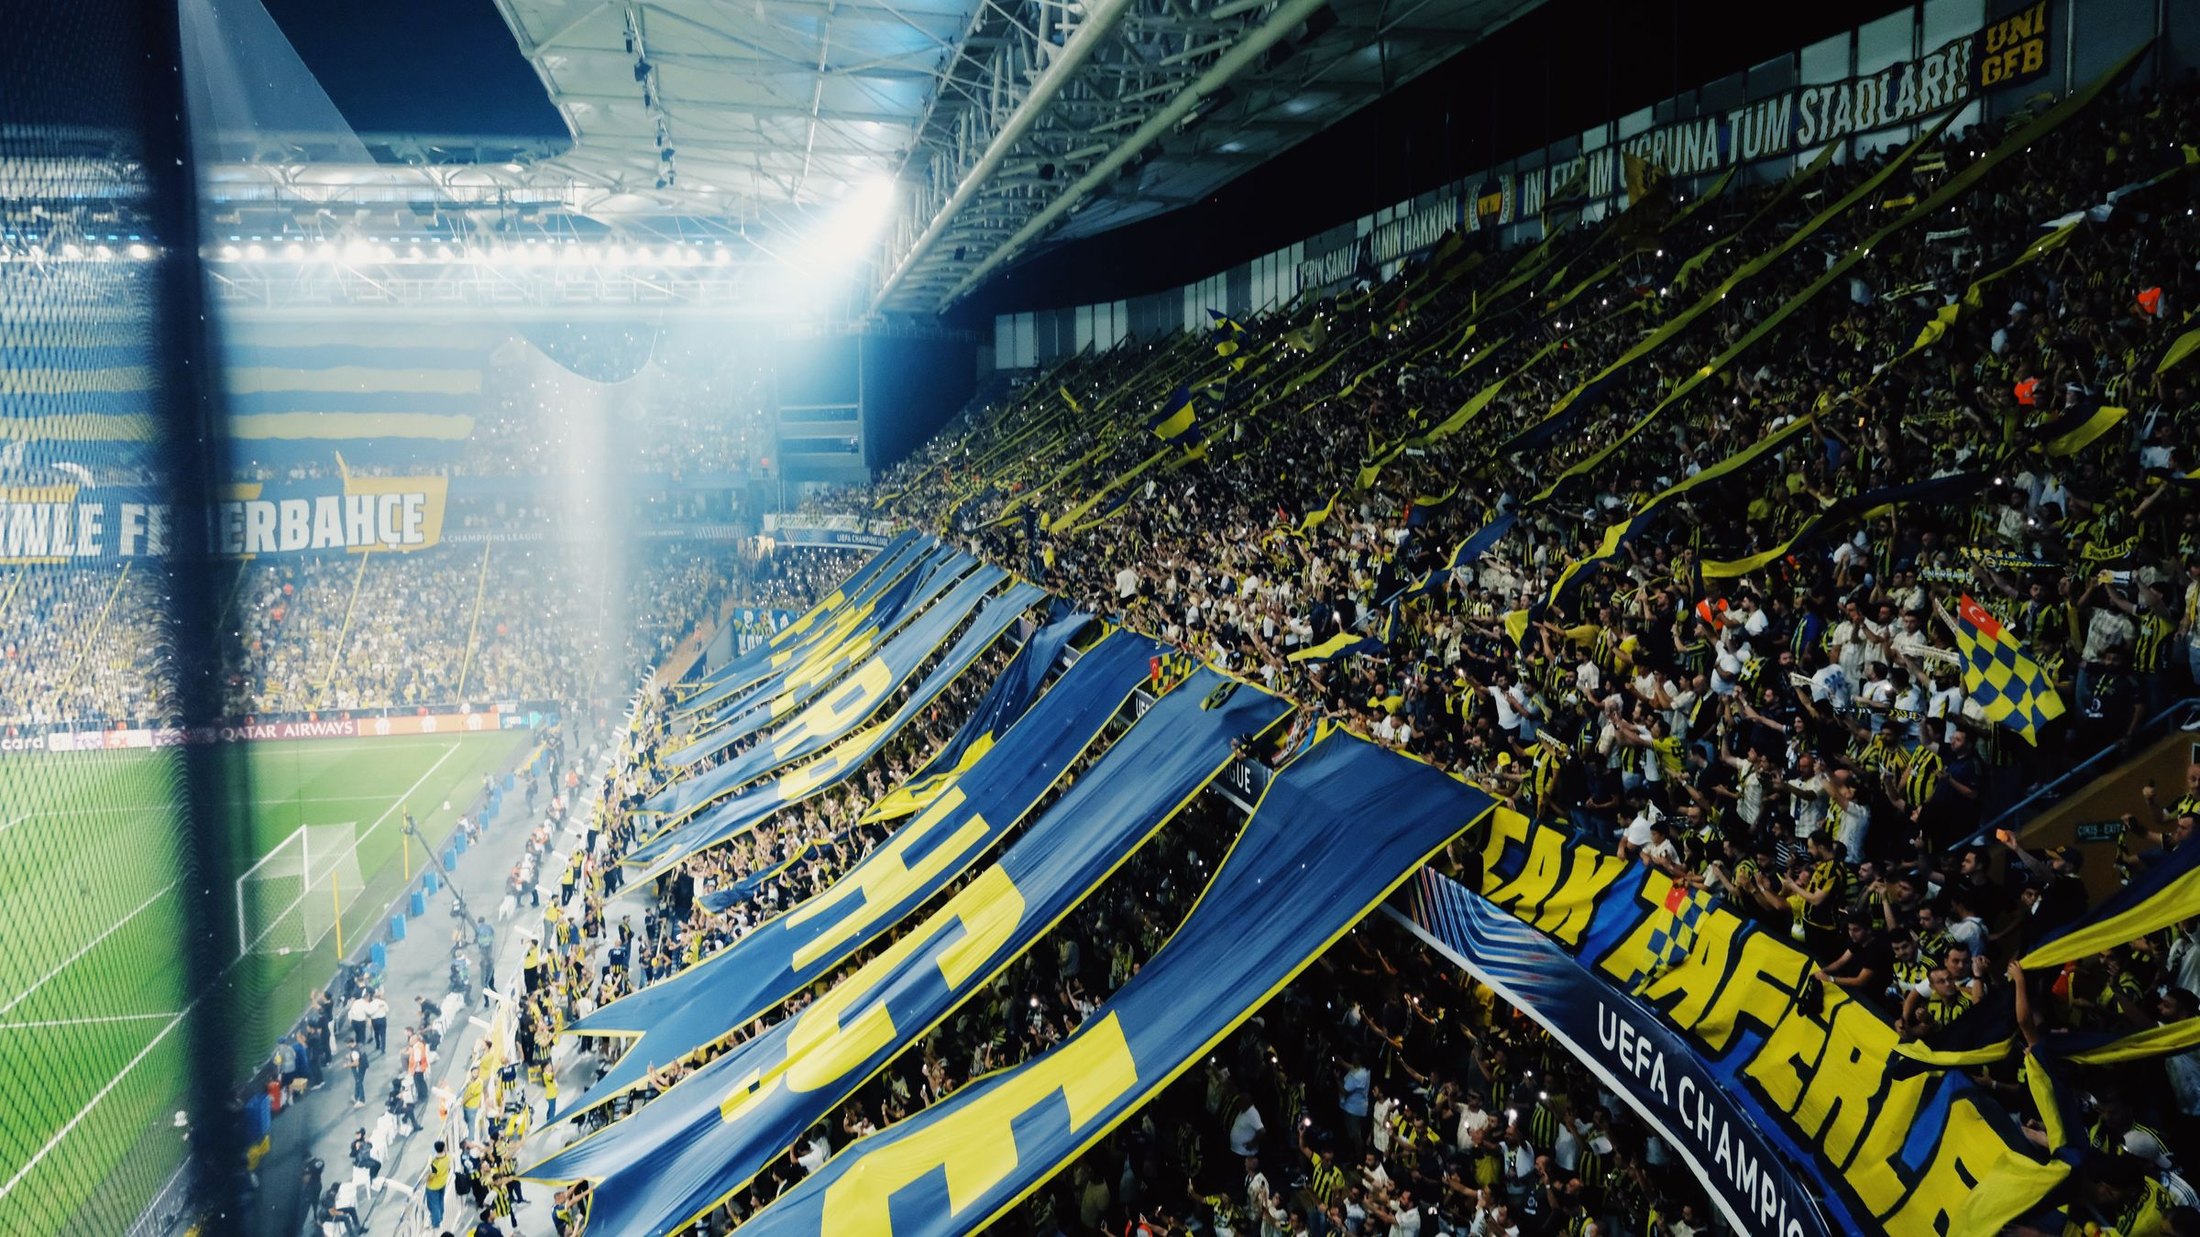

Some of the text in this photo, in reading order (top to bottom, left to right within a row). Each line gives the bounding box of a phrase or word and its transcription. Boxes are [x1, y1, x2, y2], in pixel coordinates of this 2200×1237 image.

[1985, 0, 2047, 54] UNI
[1981, 38, 2046, 88] GFB
[119, 492, 426, 556] FEERBAHÇE
[219, 721, 354, 744] QATAR AIRWAYS
[1598, 1003, 1672, 1108] UEFA
